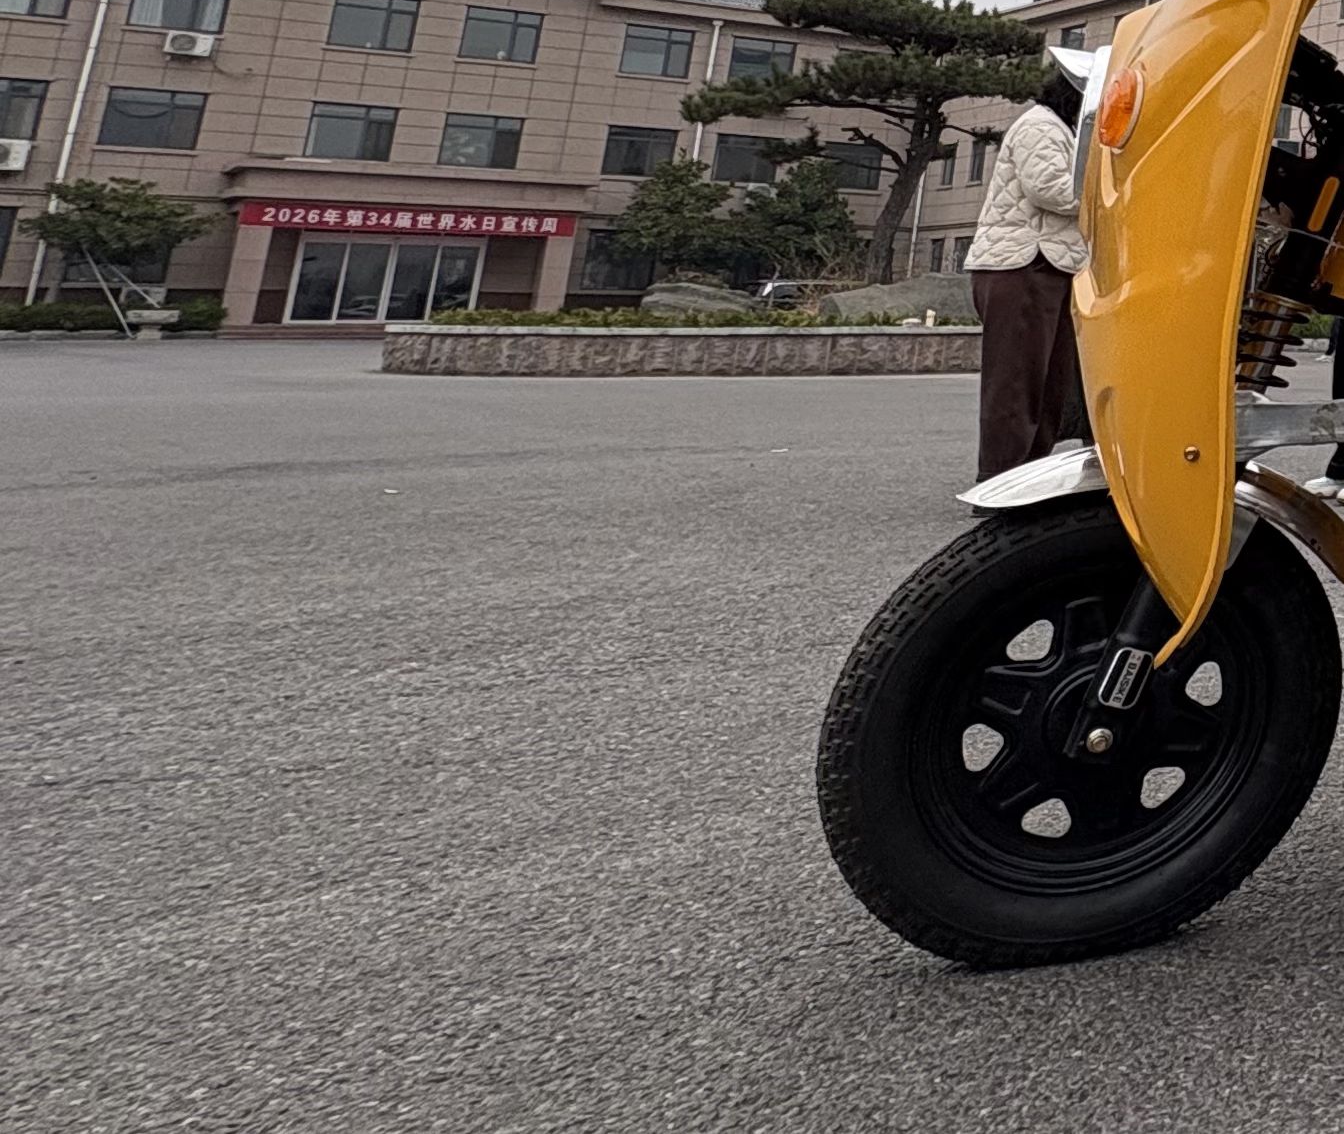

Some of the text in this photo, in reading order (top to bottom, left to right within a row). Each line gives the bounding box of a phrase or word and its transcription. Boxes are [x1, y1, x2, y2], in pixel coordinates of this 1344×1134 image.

[262, 206, 559, 234] 2026年第34届世界水日宣传周
